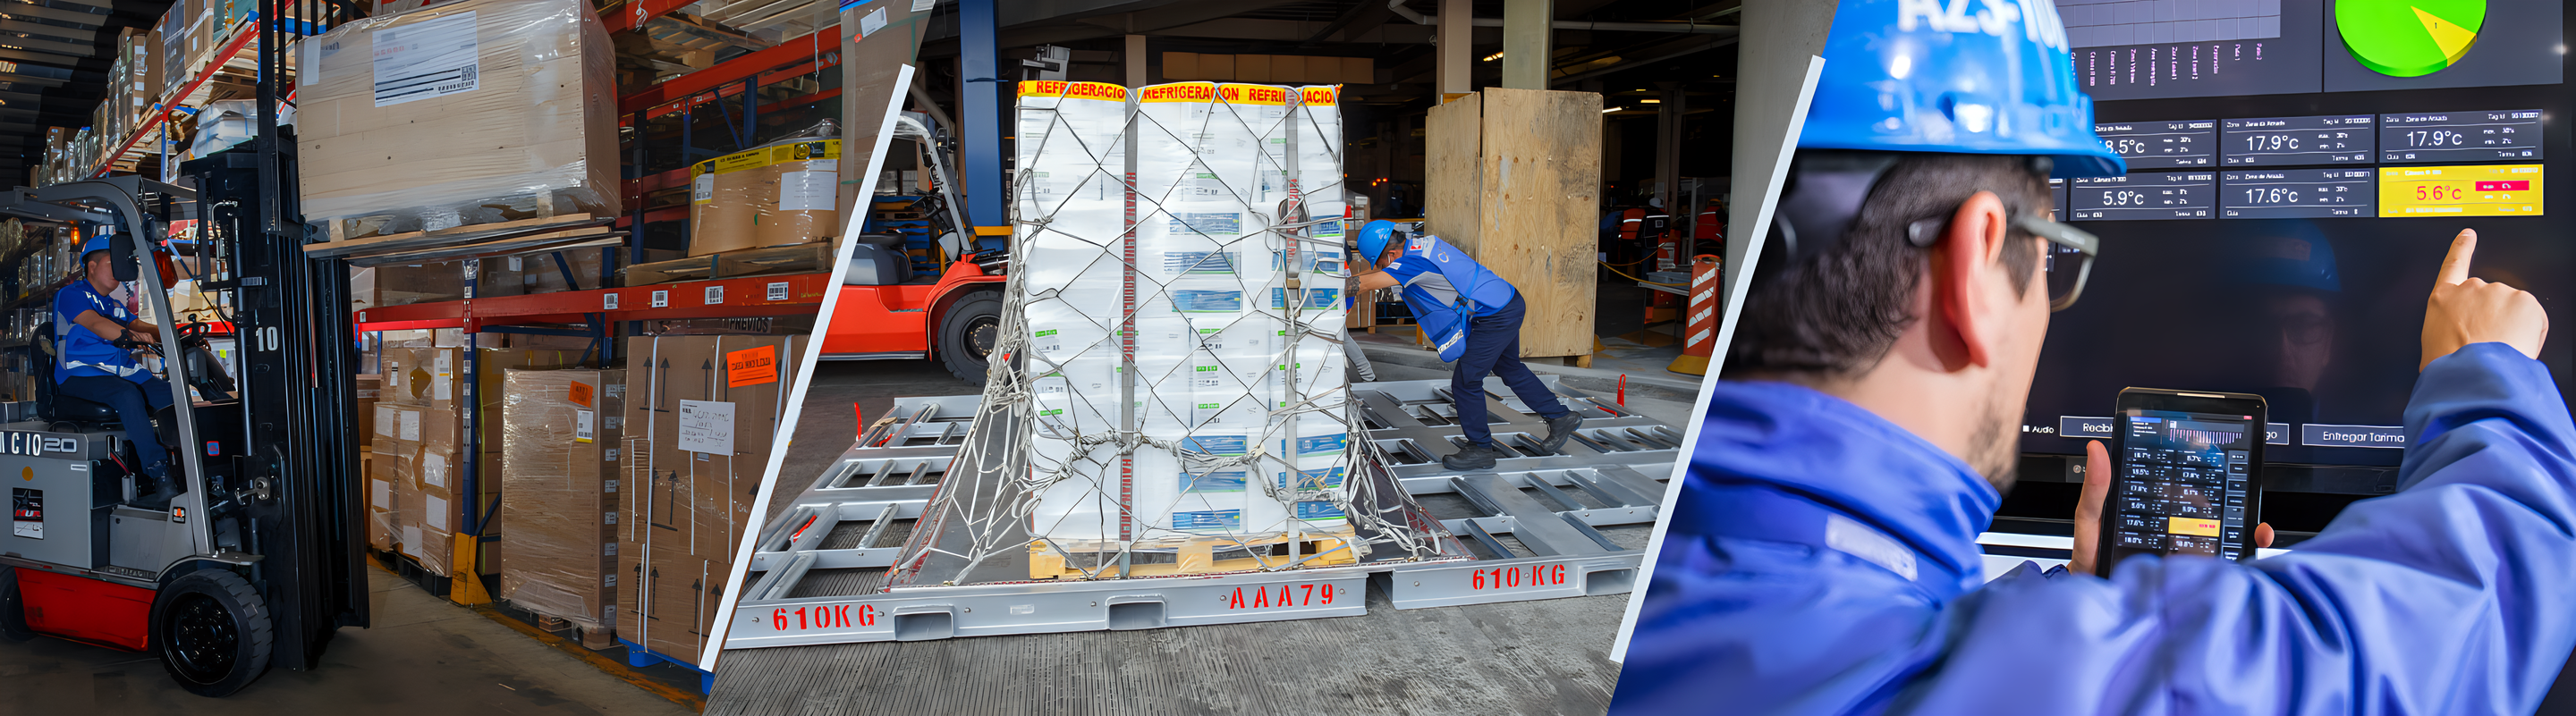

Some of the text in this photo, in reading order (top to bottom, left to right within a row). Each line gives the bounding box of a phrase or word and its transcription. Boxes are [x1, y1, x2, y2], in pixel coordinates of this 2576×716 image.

[1037, 81, 1125, 99] REFRIGERACIO
[256, 326, 278, 351] 10
[2031, 425, 2055, 434] Audio
[2323, 431, 2368, 443] Entregar
[43, 437, 77, 453] 20
[1472, 564, 1565, 590] 610 KG
